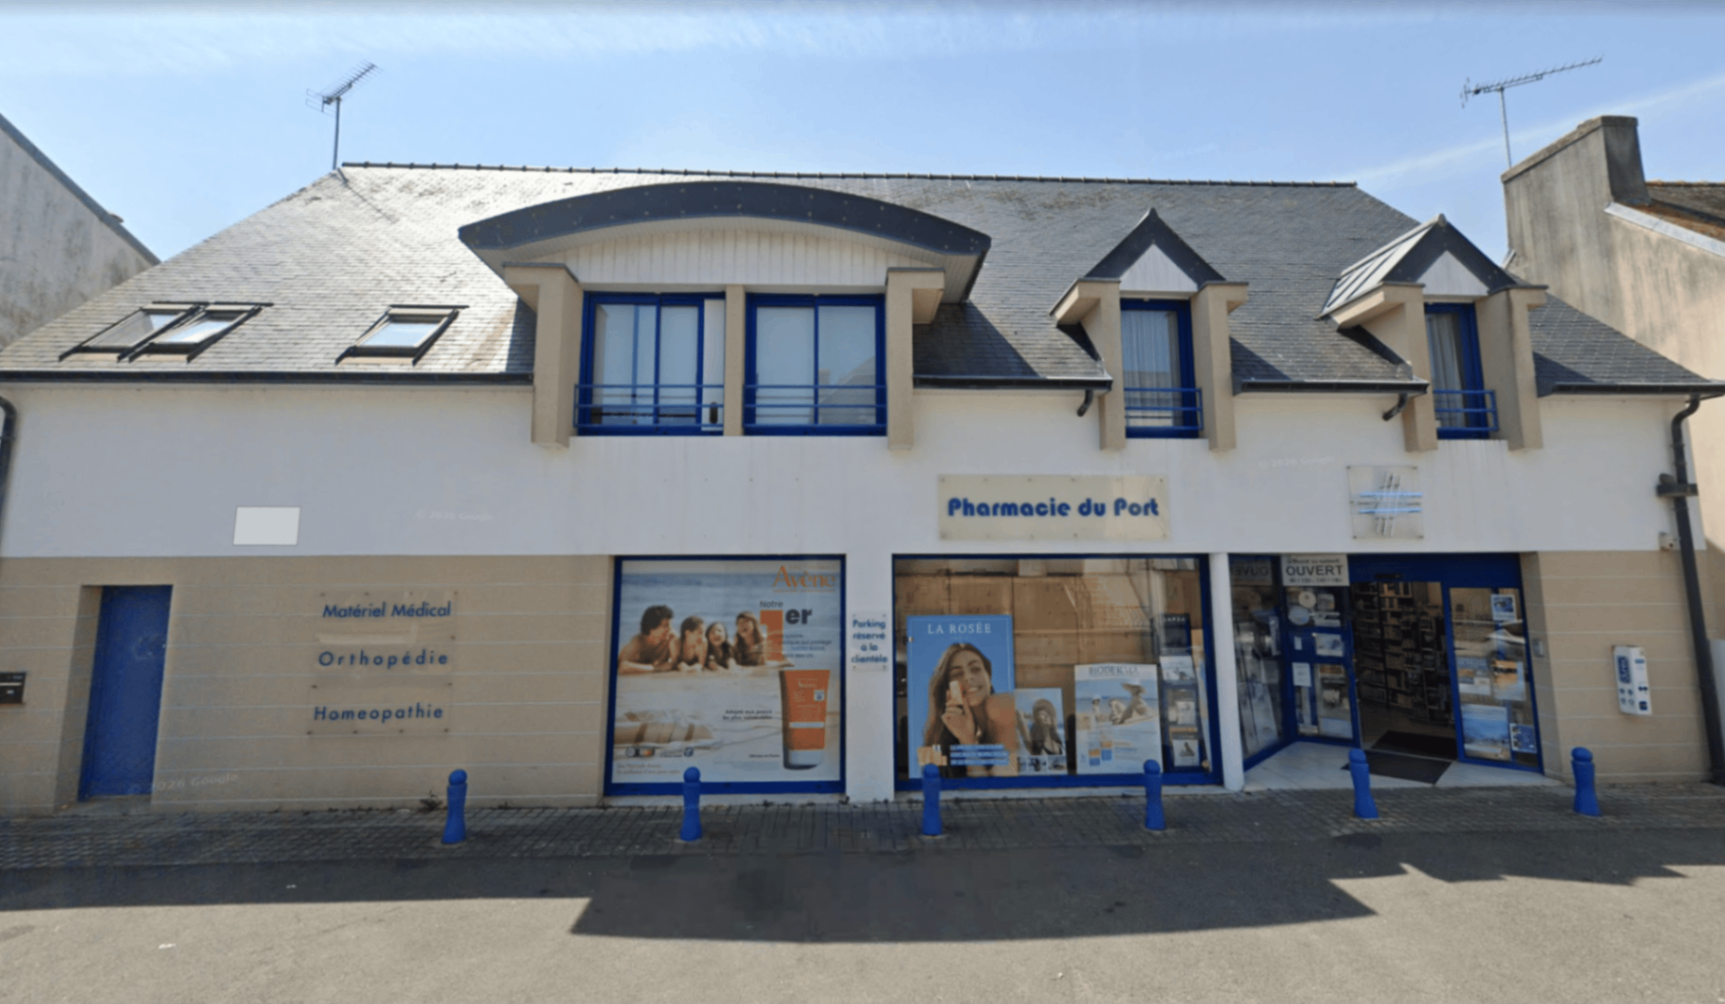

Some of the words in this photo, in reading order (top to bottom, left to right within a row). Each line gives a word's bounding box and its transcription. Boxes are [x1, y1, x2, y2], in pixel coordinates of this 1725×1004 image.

[948, 498, 1071, 517] Pharmacie
[1077, 498, 1106, 517] du
[1113, 498, 1159, 516] Port
[772, 565, 836, 588] Avène
[1285, 565, 1343, 576] OUVERT
[322, 601, 386, 619] Matériel
[391, 600, 451, 618] Médical
[759, 600, 783, 608] Notre
[852, 619, 886, 630] Parking
[927, 623, 944, 635] LA
[949, 621, 991, 635] ROSÉE
[852, 632, 886, 640] réservé
[869, 642, 878, 651] la
[318, 648, 448, 670] Orthopédie
[313, 702, 443, 724] Homeopathie
